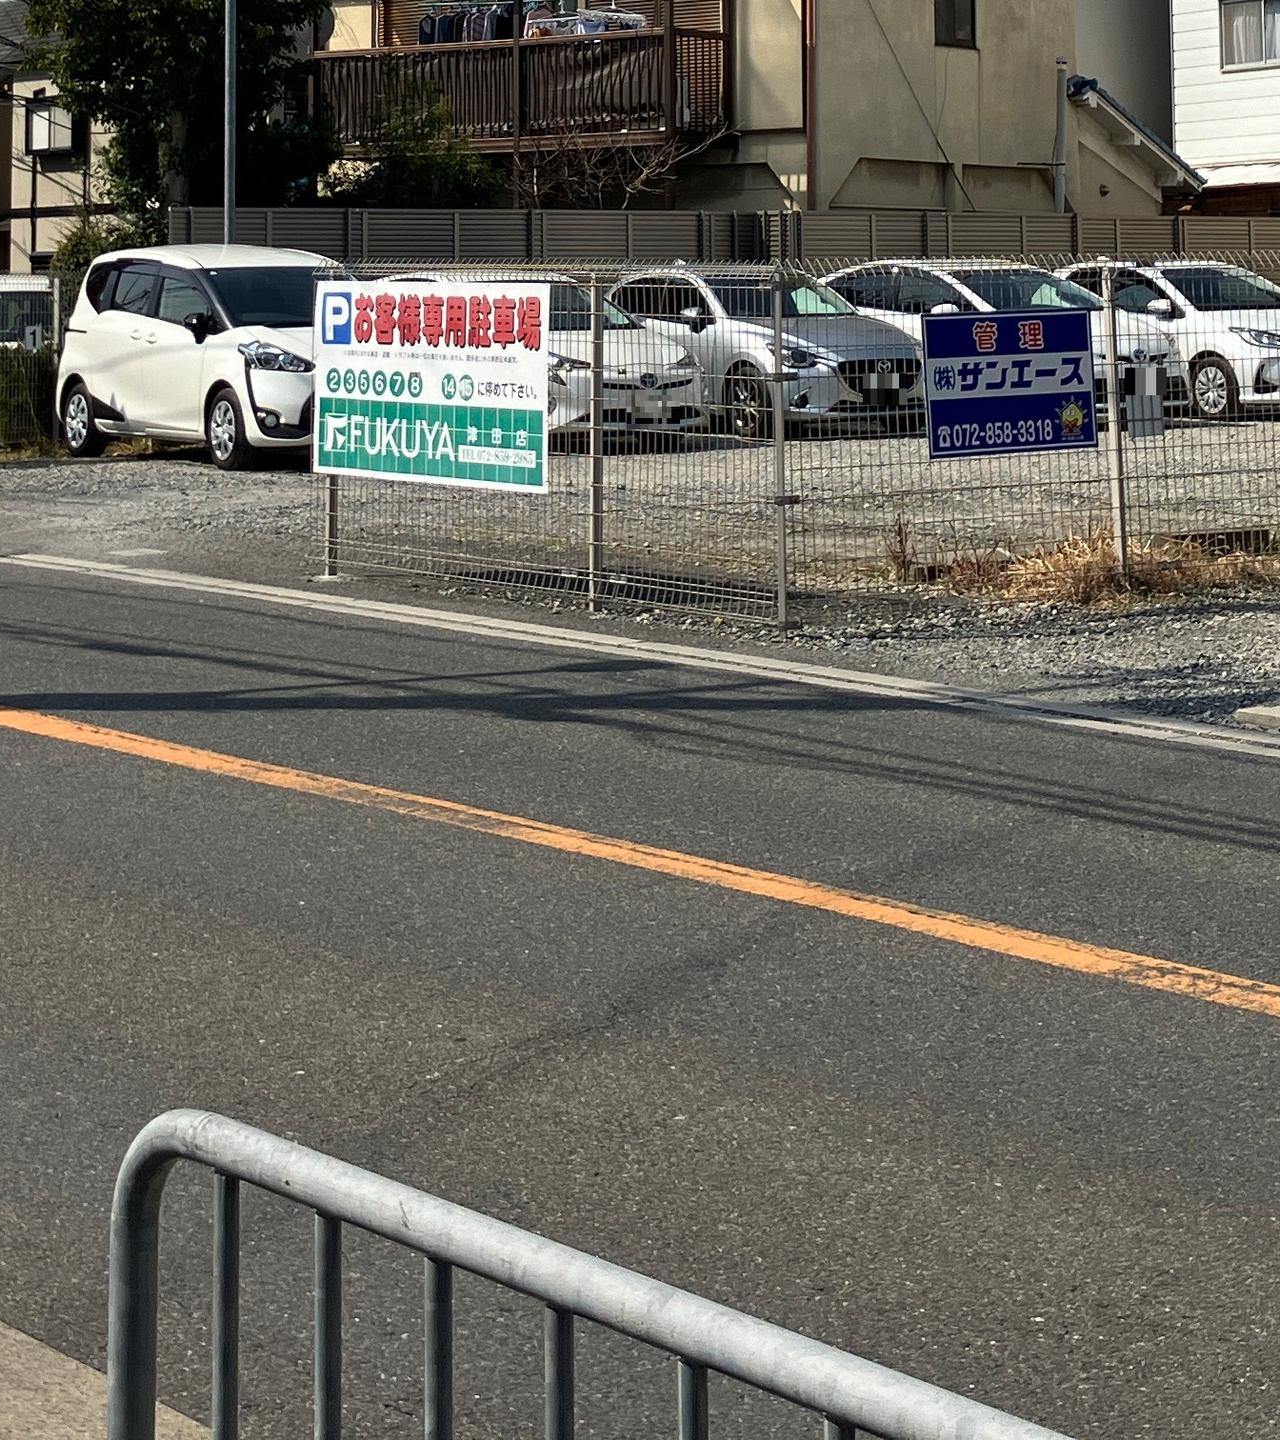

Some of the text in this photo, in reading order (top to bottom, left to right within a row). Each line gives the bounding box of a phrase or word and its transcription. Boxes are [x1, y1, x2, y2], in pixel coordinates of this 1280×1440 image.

[325, 293, 541, 351] P お客様専用駐車場
[973, 320, 1044, 352] 管理
[30, 329, 37, 347] 1
[478, 380, 538, 400] に停めて下さい。
[351, 416, 455, 462] FUKUYA
[467, 426, 529, 447] 津田店
[953, 419, 1053, 447] 072-858-3318
